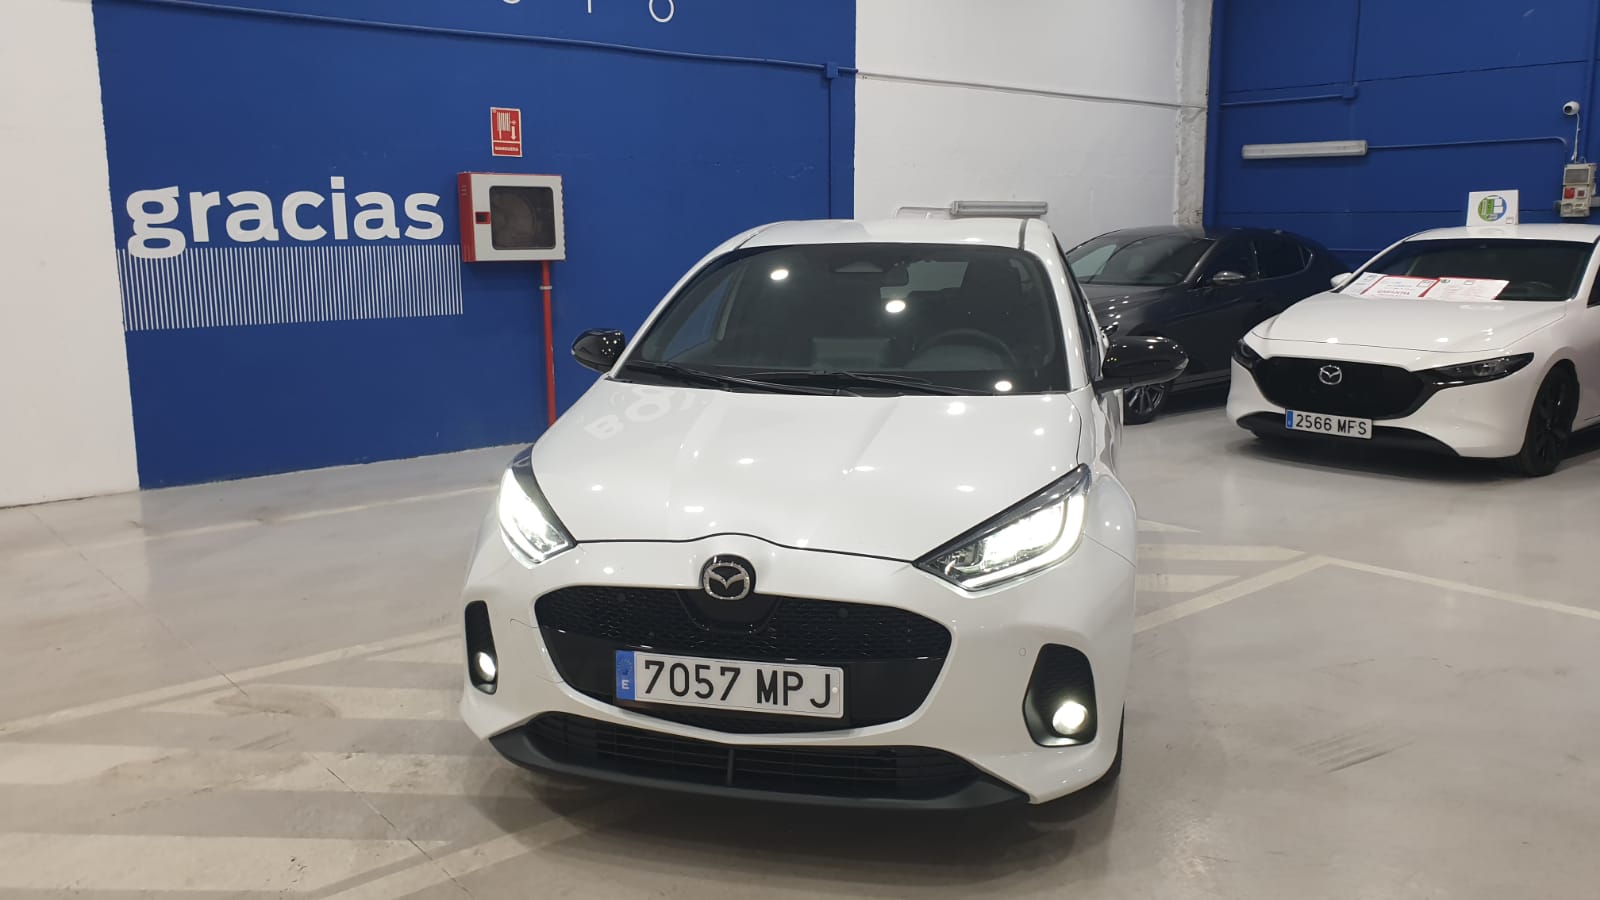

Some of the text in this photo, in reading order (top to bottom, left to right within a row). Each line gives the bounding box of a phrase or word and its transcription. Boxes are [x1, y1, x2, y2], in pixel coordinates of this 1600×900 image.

[126, 176, 445, 259] gracias
[1296, 414, 1367, 435] 2566 MFS
[621, 679, 630, 690] E
[644, 659, 831, 709] 7057 MPJ
